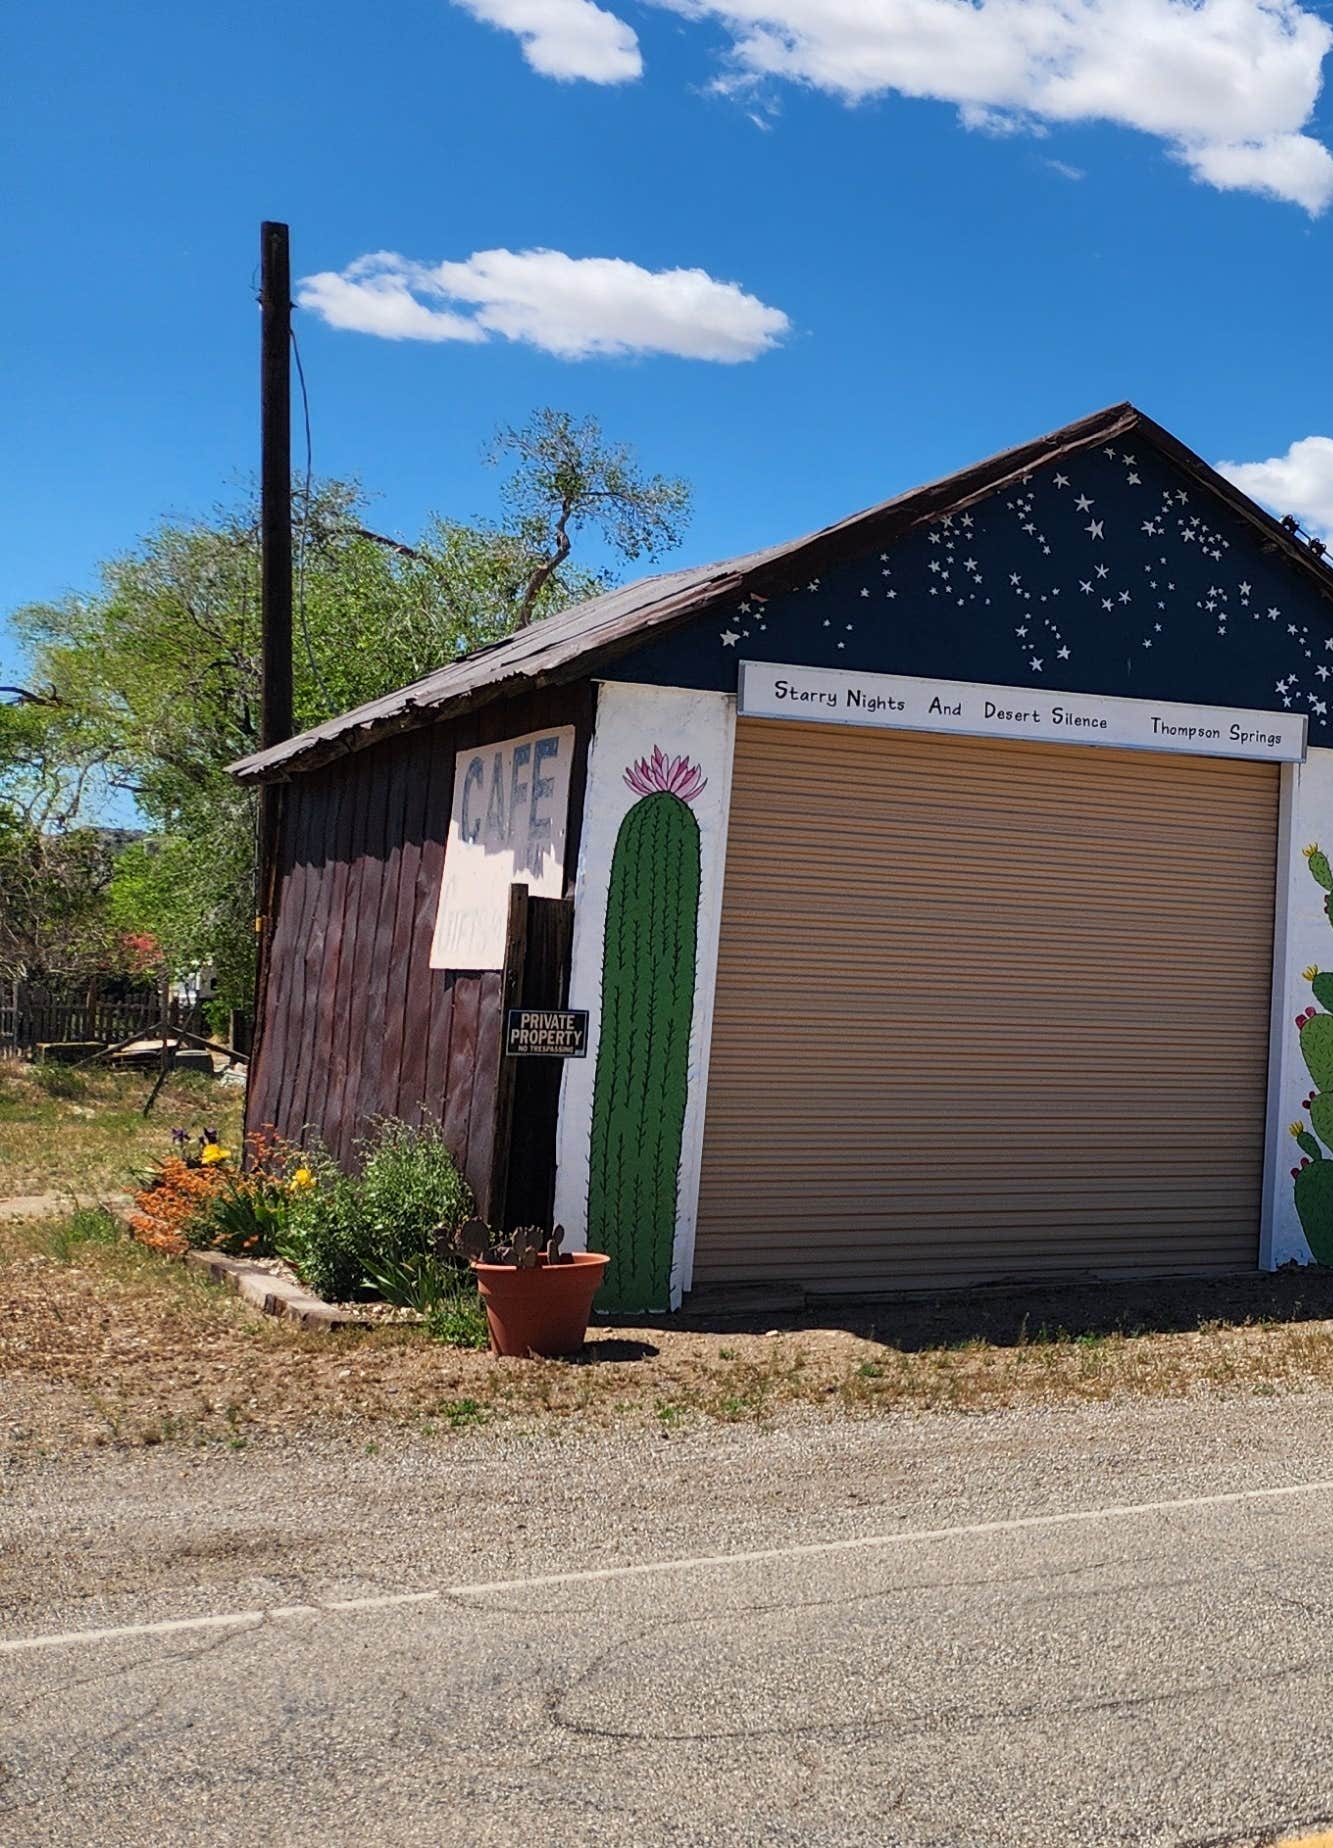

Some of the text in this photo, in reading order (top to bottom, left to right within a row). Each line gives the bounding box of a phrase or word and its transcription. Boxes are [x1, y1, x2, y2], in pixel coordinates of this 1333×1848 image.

[774, 680, 1282, 747] Starry Nights And Desert Silence Thompson Springs
[461, 736, 560, 844] CAFE
[521, 1012, 576, 1030] PRIVATE
[510, 1028, 583, 1046] PROPERTY
[530, 1045, 575, 1054] TRESPASSING
